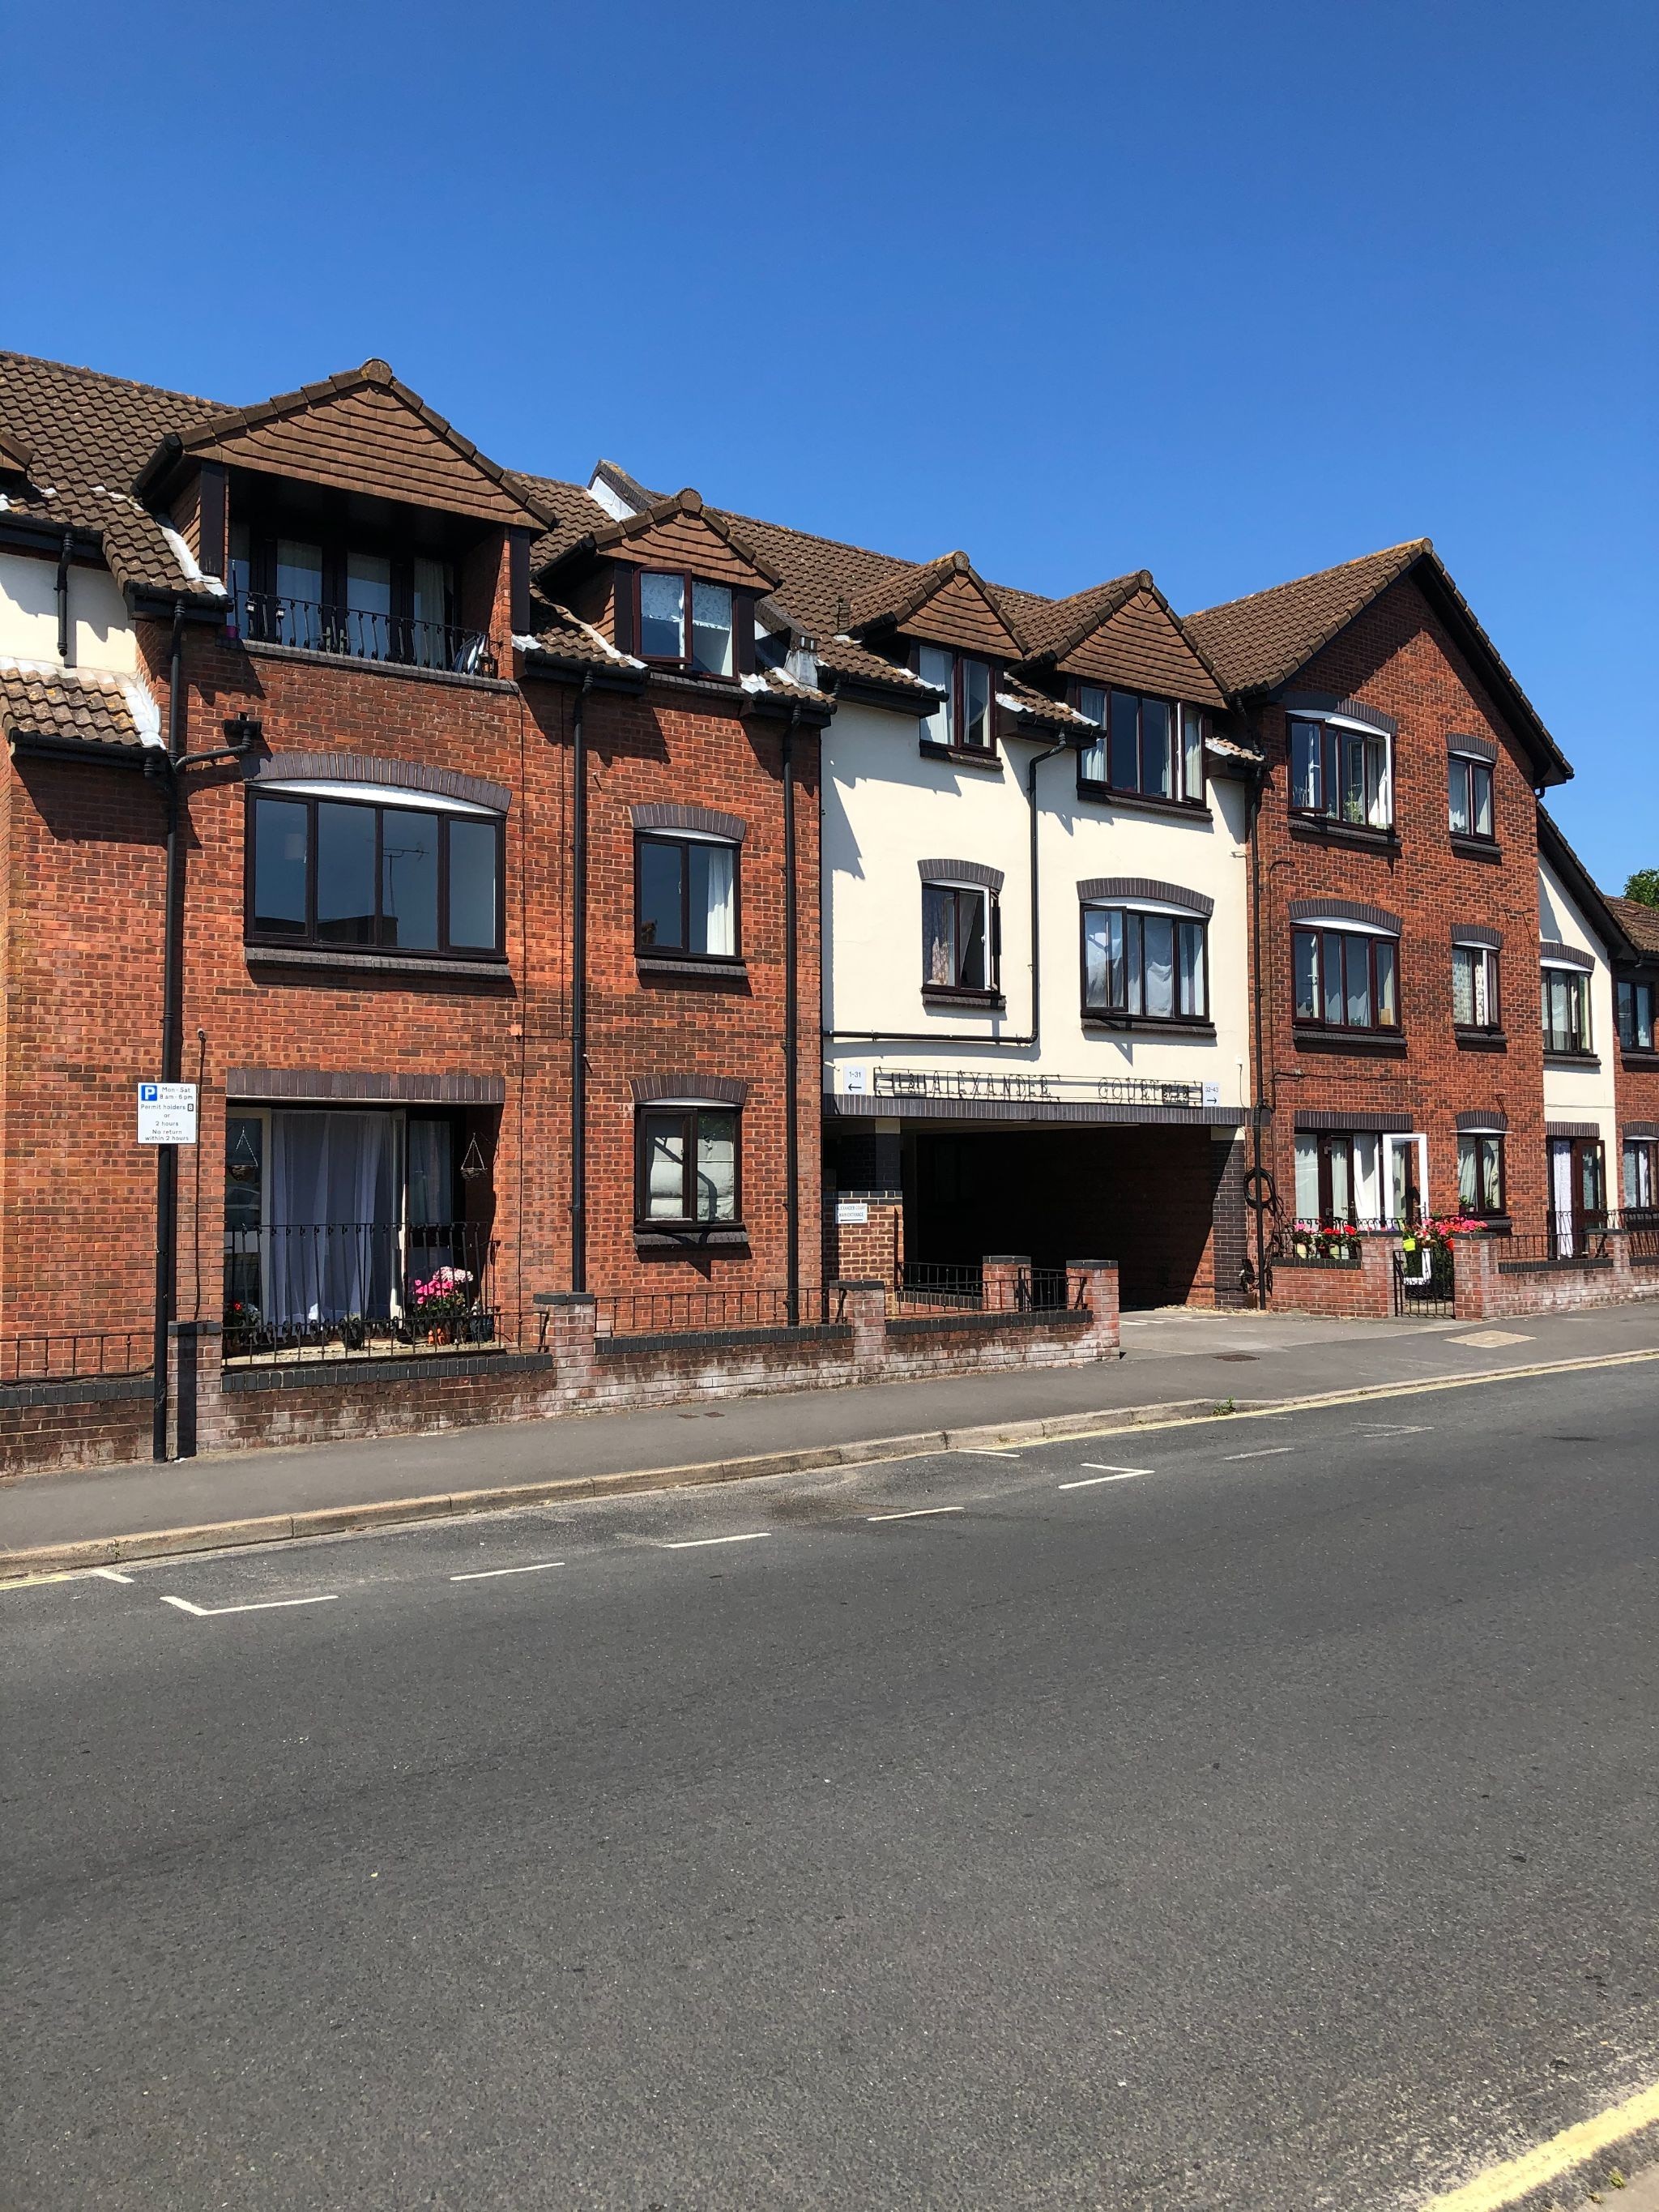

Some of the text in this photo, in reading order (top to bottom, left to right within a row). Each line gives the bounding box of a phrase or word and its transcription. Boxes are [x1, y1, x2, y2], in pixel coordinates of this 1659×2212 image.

[145, 1087, 156, 1100] P
[929, 1070, 1051, 1097] ALEXANDER
[1098, 1078, 1158, 1100] COURT
